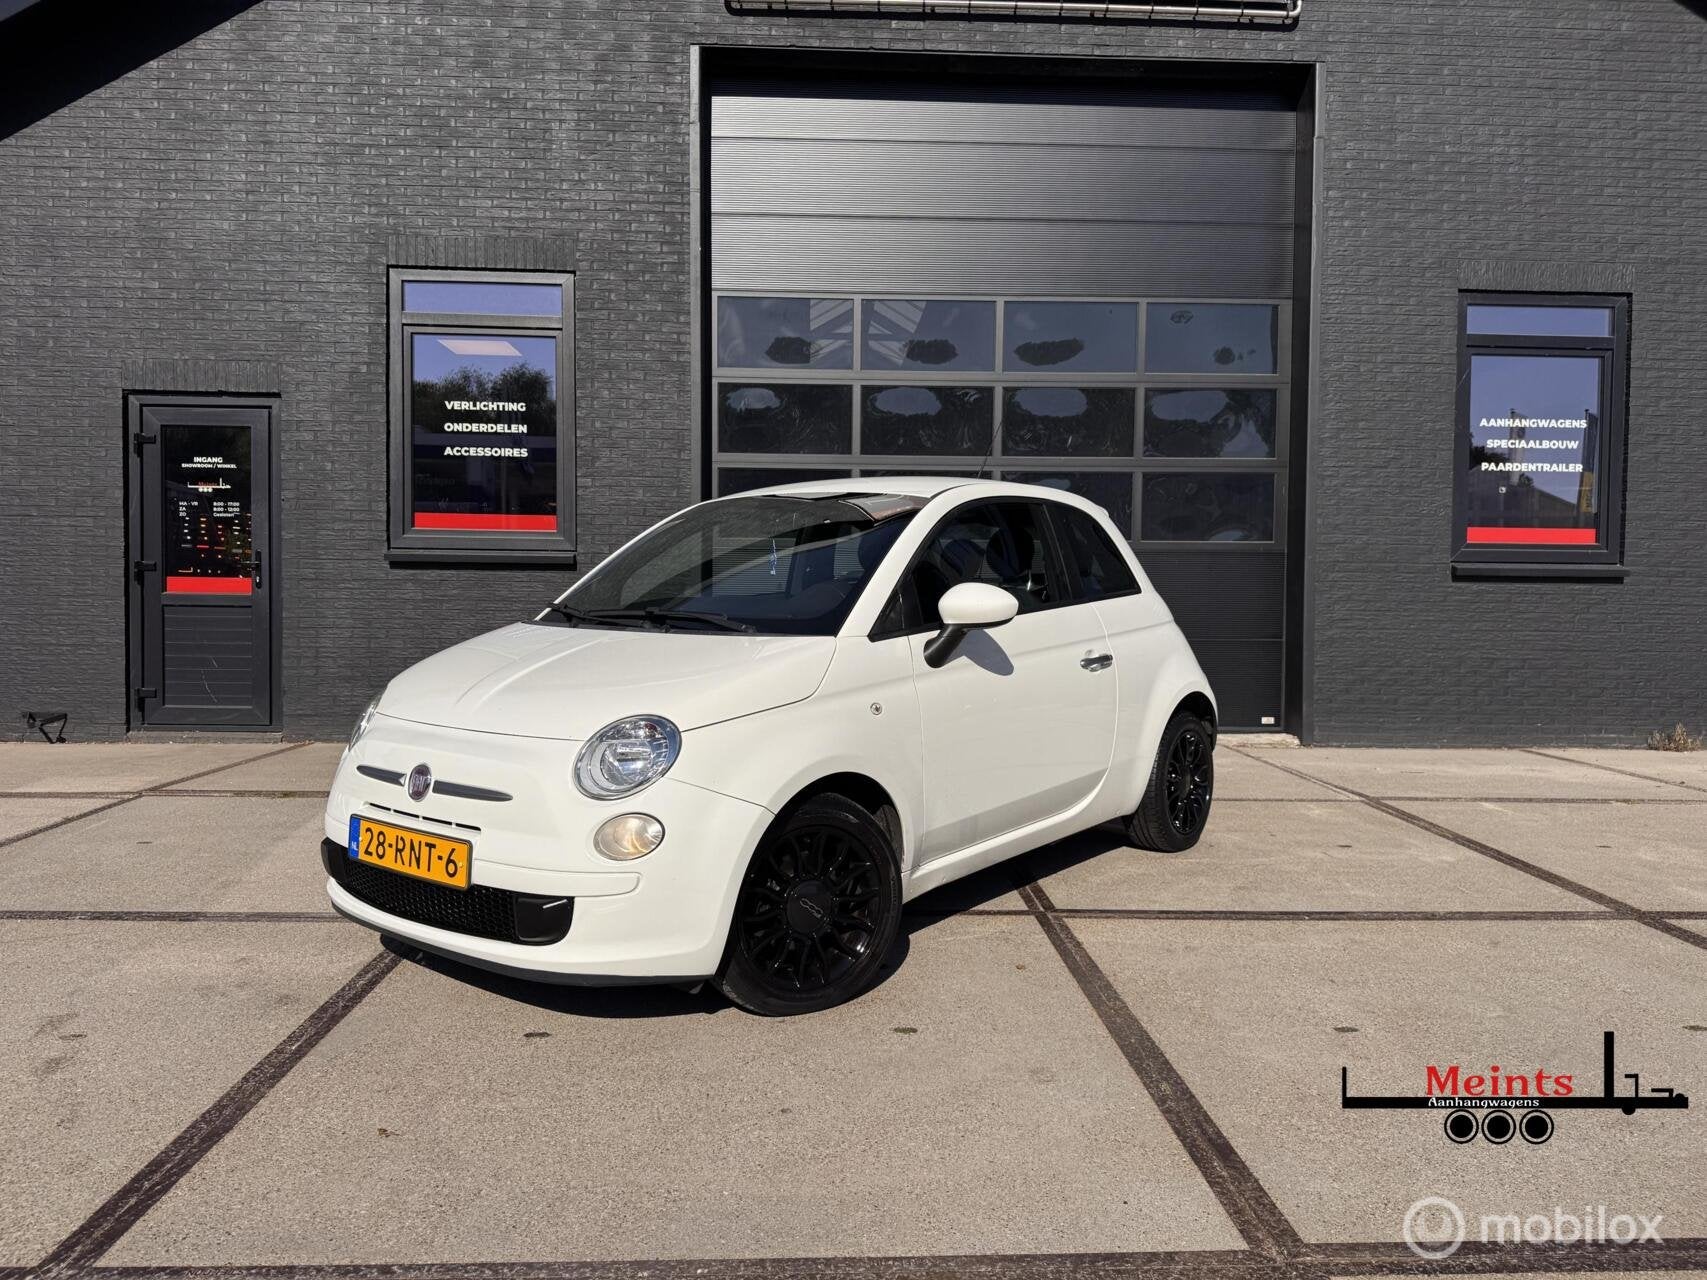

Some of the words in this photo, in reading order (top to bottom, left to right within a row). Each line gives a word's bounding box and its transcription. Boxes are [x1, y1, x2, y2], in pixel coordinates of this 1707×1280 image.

[444, 400, 527, 412] VERLICHTING
[443, 422, 528, 434] ONDERDELEN
[1479, 418, 1588, 429] AANHANGWAGENS
[1486, 439, 1580, 450] SPECIAALBOUW
[443, 446, 529, 458] ACCESSOIRES
[1480, 462, 1584, 473] PAARDENTRAILER
[363, 826, 459, 879] 28-RNT-6
